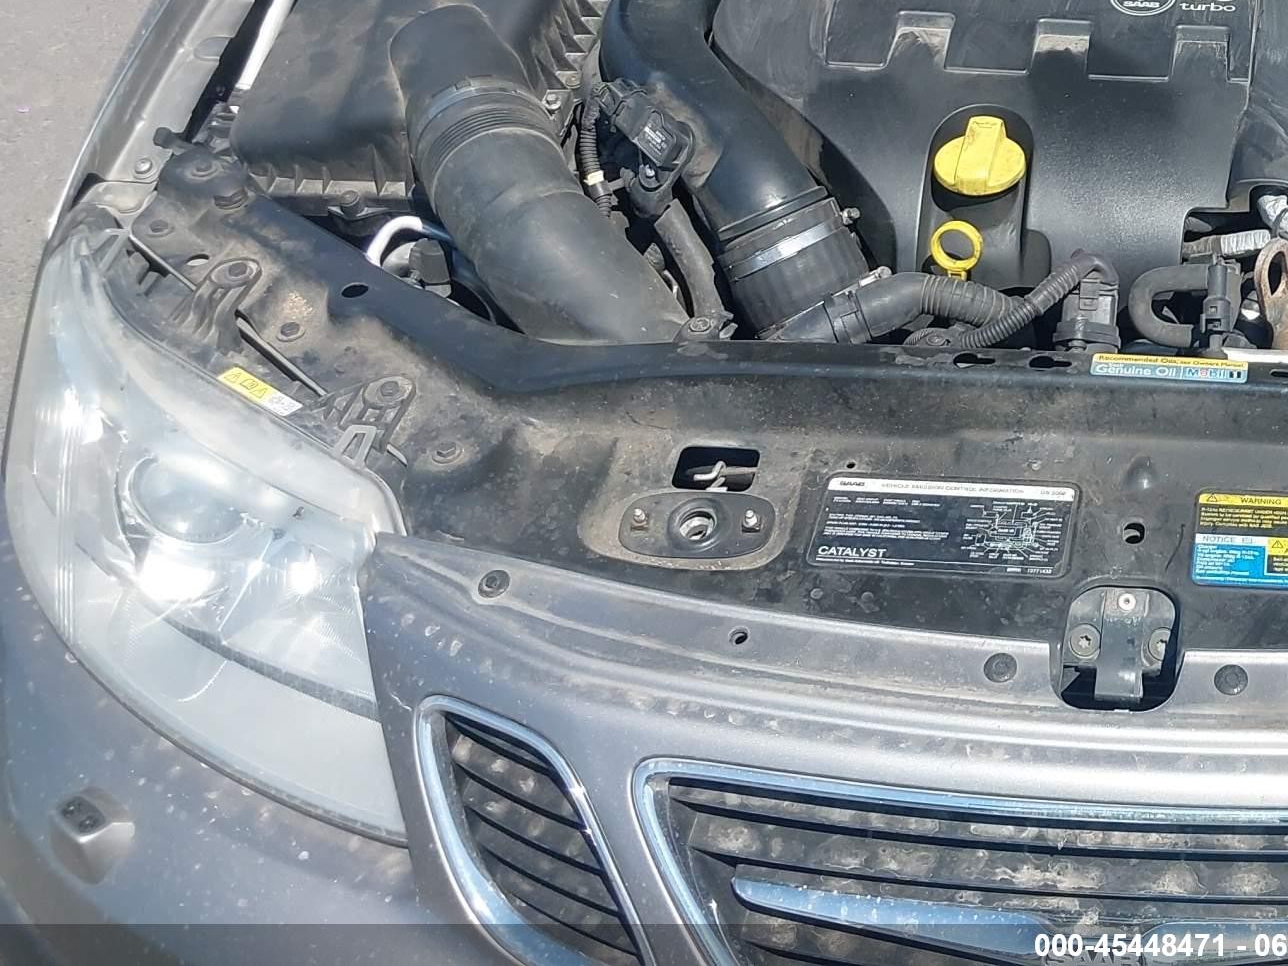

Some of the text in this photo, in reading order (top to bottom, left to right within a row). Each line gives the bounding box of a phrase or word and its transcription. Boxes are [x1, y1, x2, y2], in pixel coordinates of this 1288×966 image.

[1122, 0, 1161, 8] SAAB
[1179, 2, 1237, 12] turbo
[1095, 364, 1177, 377] Genuine Oil
[1186, 368, 1227, 379] Mobil
[1240, 497, 1282, 506] WARNING
[1202, 535, 1236, 544] NOTICE
[818, 545, 887, 558] CATALYST
